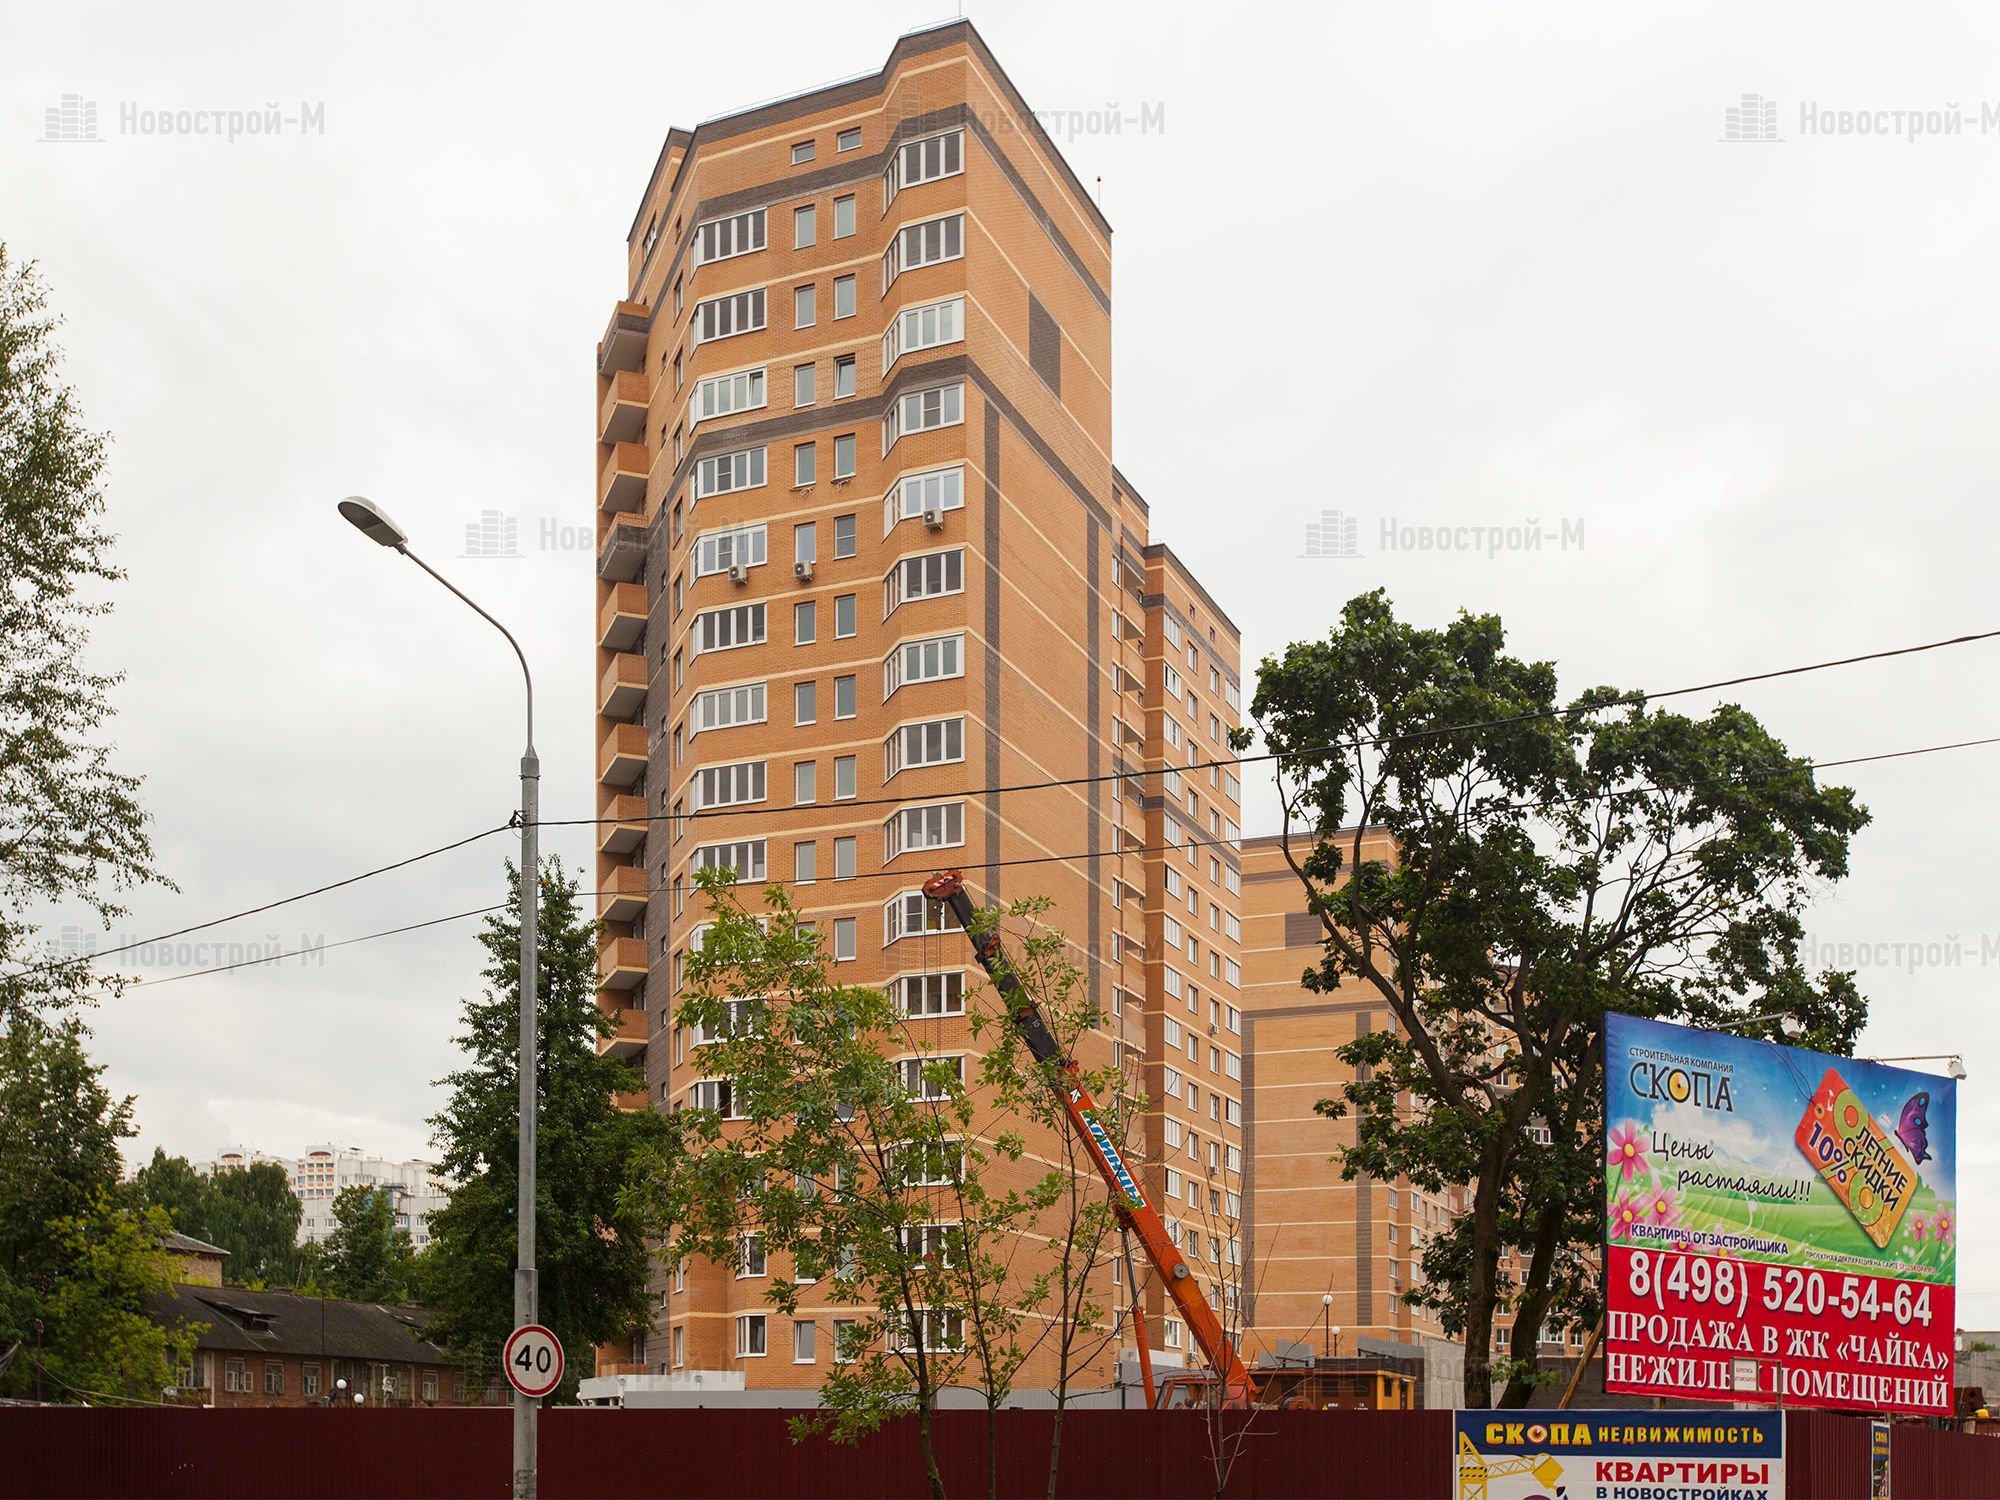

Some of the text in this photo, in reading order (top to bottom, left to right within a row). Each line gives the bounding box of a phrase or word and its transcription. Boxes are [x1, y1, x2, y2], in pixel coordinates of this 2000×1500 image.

[1629, 1047, 1734, 1073] СТРОИТЕЛЬНАЯ КОМПАНИЯ
[1629, 1062, 1733, 1112] СКОПА
[1652, 1131, 1714, 1161] Цены
[1809, 1122, 1849, 1183] 10%
[1856, 1126, 1908, 1194] ЛЕТНИЕ
[1677, 1169, 1811, 1202] растаяли!!!
[1843, 1137, 1901, 1212] СКИДКИ
[1631, 1224, 1789, 1254] КВАРТИРЫ ОТ ЗАСТРОЙЩИКА
[1629, 1251, 1932, 1327] 8(498) 520-54-64
[1607, 1310, 1949, 1370] ПРОДАЖА В ЖК «ЧАЙКА»
[515, 1344, 551, 1373] 40
[1771, 1366, 1949, 1409] ПОМЕЩЕНИЙ
[1485, 1423, 1764, 1446] СКОПА НЕДВИЖИМОСТЬ
[1595, 1461, 1769, 1485] КВАРТИРЫ
[1596, 1486, 1769, 1500] В НОВОСТРОЙКАХ
